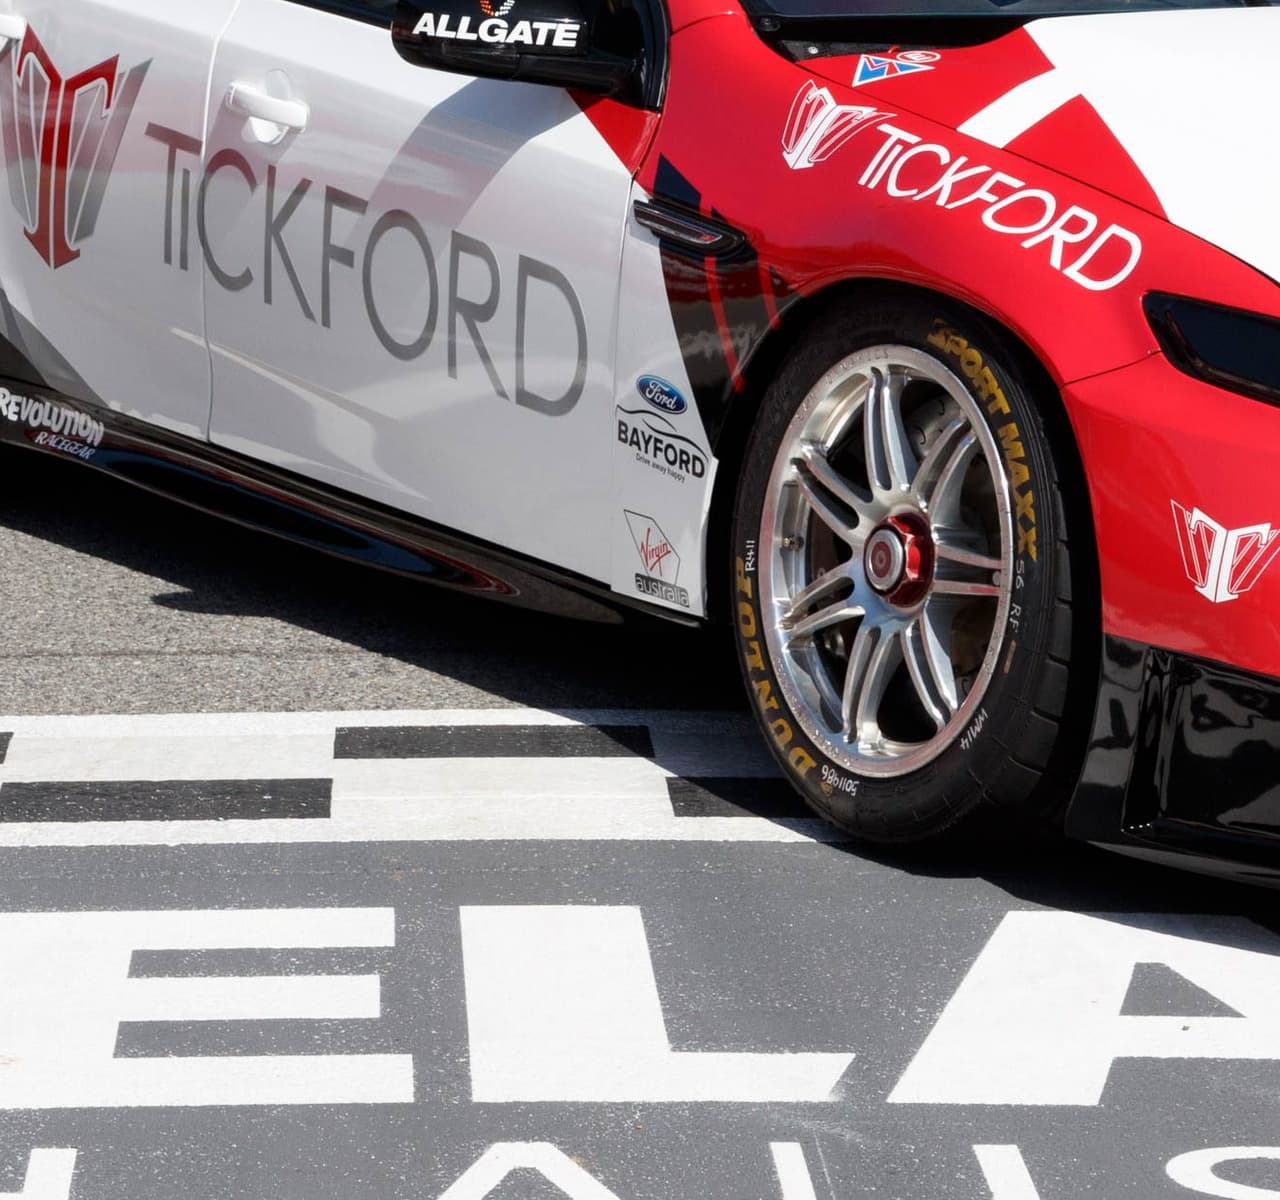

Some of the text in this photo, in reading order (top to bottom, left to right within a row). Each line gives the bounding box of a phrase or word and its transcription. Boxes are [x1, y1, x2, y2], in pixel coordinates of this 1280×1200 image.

[412, 12, 581, 47] ALLGATE
[858, 124, 1142, 291] TICKFORD
[145, 122, 588, 417] TICKFORD
[646, 382, 677, 410] Ford
[35, 431, 95, 460] RACEGEAR
[617, 419, 705, 479] BAYFORD
[925, 318, 1038, 561] SPORT MAXX
[640, 528, 671, 577] Virgin
[745, 539, 755, 572] R411
[635, 574, 689, 607] australia
[1009, 560, 1024, 633] 56 RF
[734, 556, 818, 780] DUNLOP
